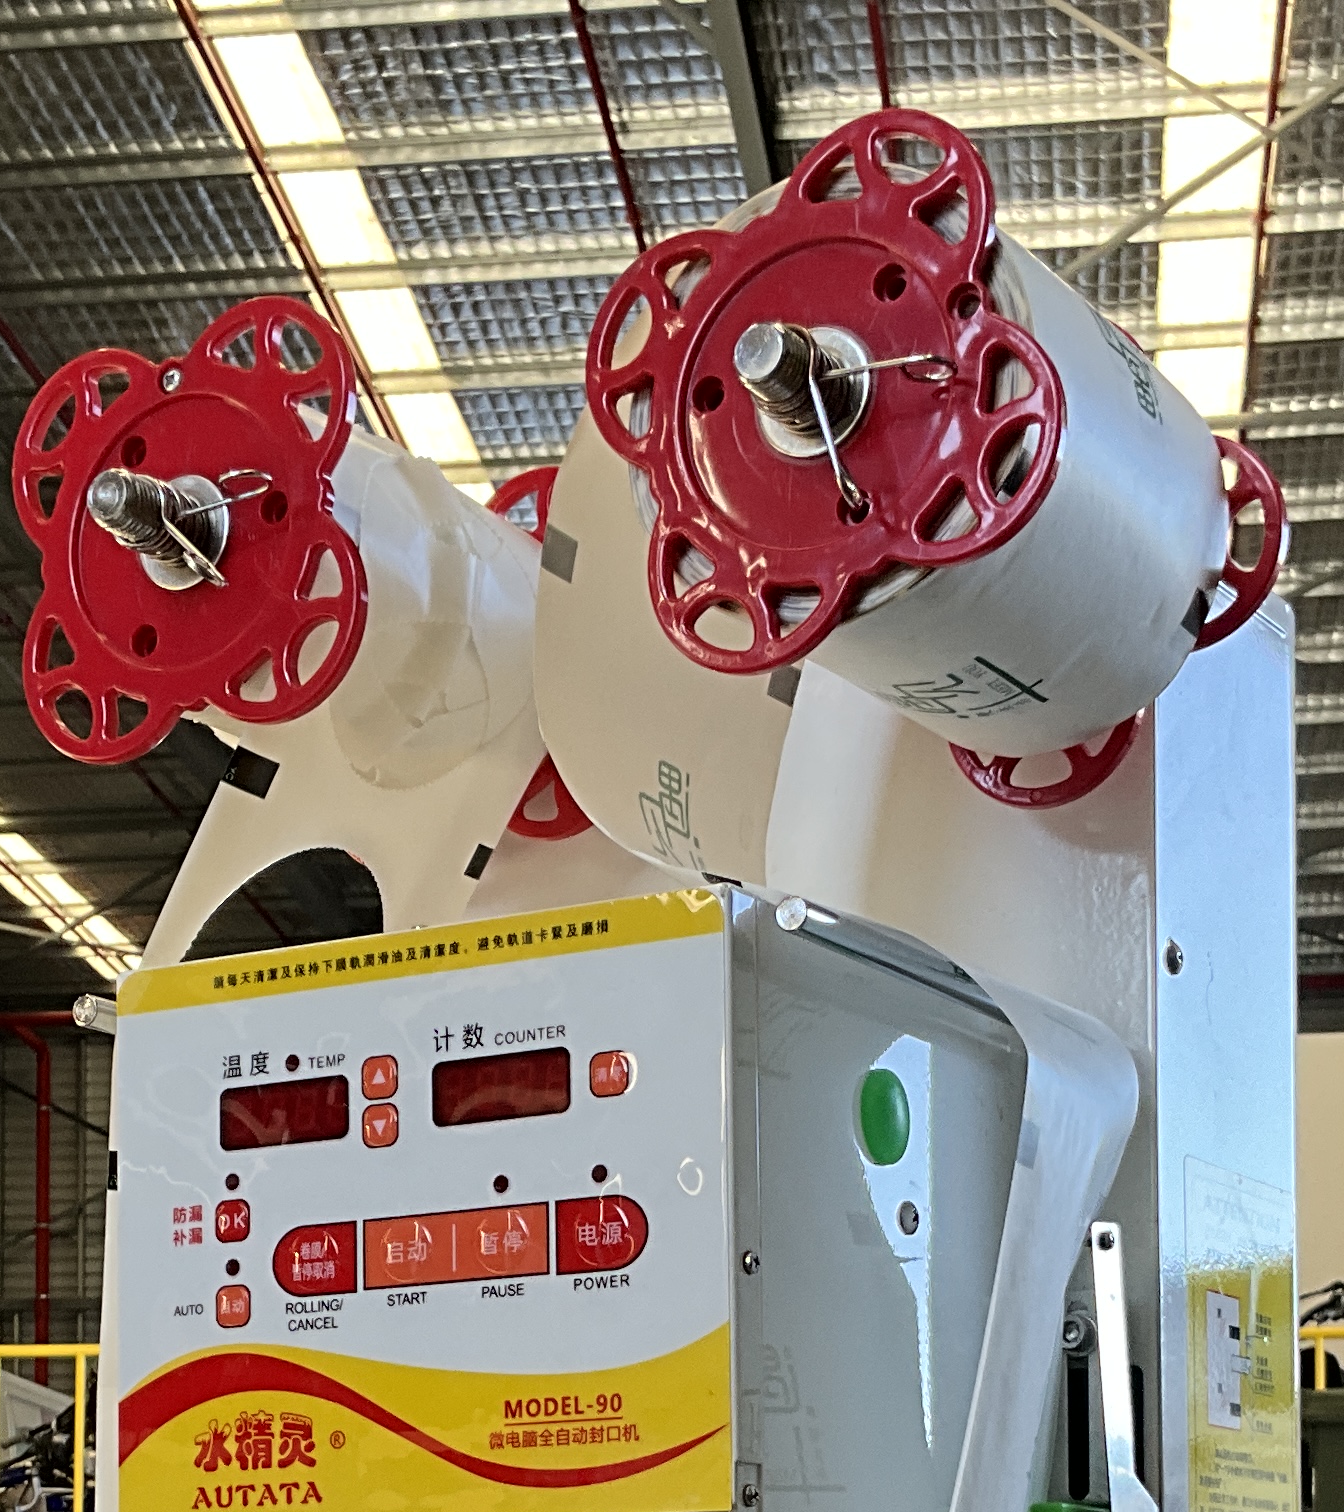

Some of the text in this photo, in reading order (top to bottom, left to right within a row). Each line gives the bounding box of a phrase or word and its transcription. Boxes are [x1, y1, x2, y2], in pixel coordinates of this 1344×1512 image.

[432, 1023, 566, 1052] 计数 COUNTER
[222, 1051, 346, 1079] 温度 TEMP
[173, 1205, 203, 1224] 防漏
[218, 1212, 247, 1232] OK
[481, 1230, 524, 1256] 暂停
[578, 1220, 624, 1247] 电源
[481, 1283, 525, 1299] PAUSE
[573, 1274, 630, 1291] POWER
[173, 1304, 204, 1316] AUTO
[285, 1299, 344, 1315] ROLLING/
[387, 1291, 427, 1307] START
[287, 1317, 339, 1332] CANCEL
[503, 1393, 623, 1419] MODEL-90
[193, 1410, 317, 1472] 水精灵
[488, 1424, 641, 1450] 微电脑全自动封口机
[191, 1481, 323, 1510] AUTATA
